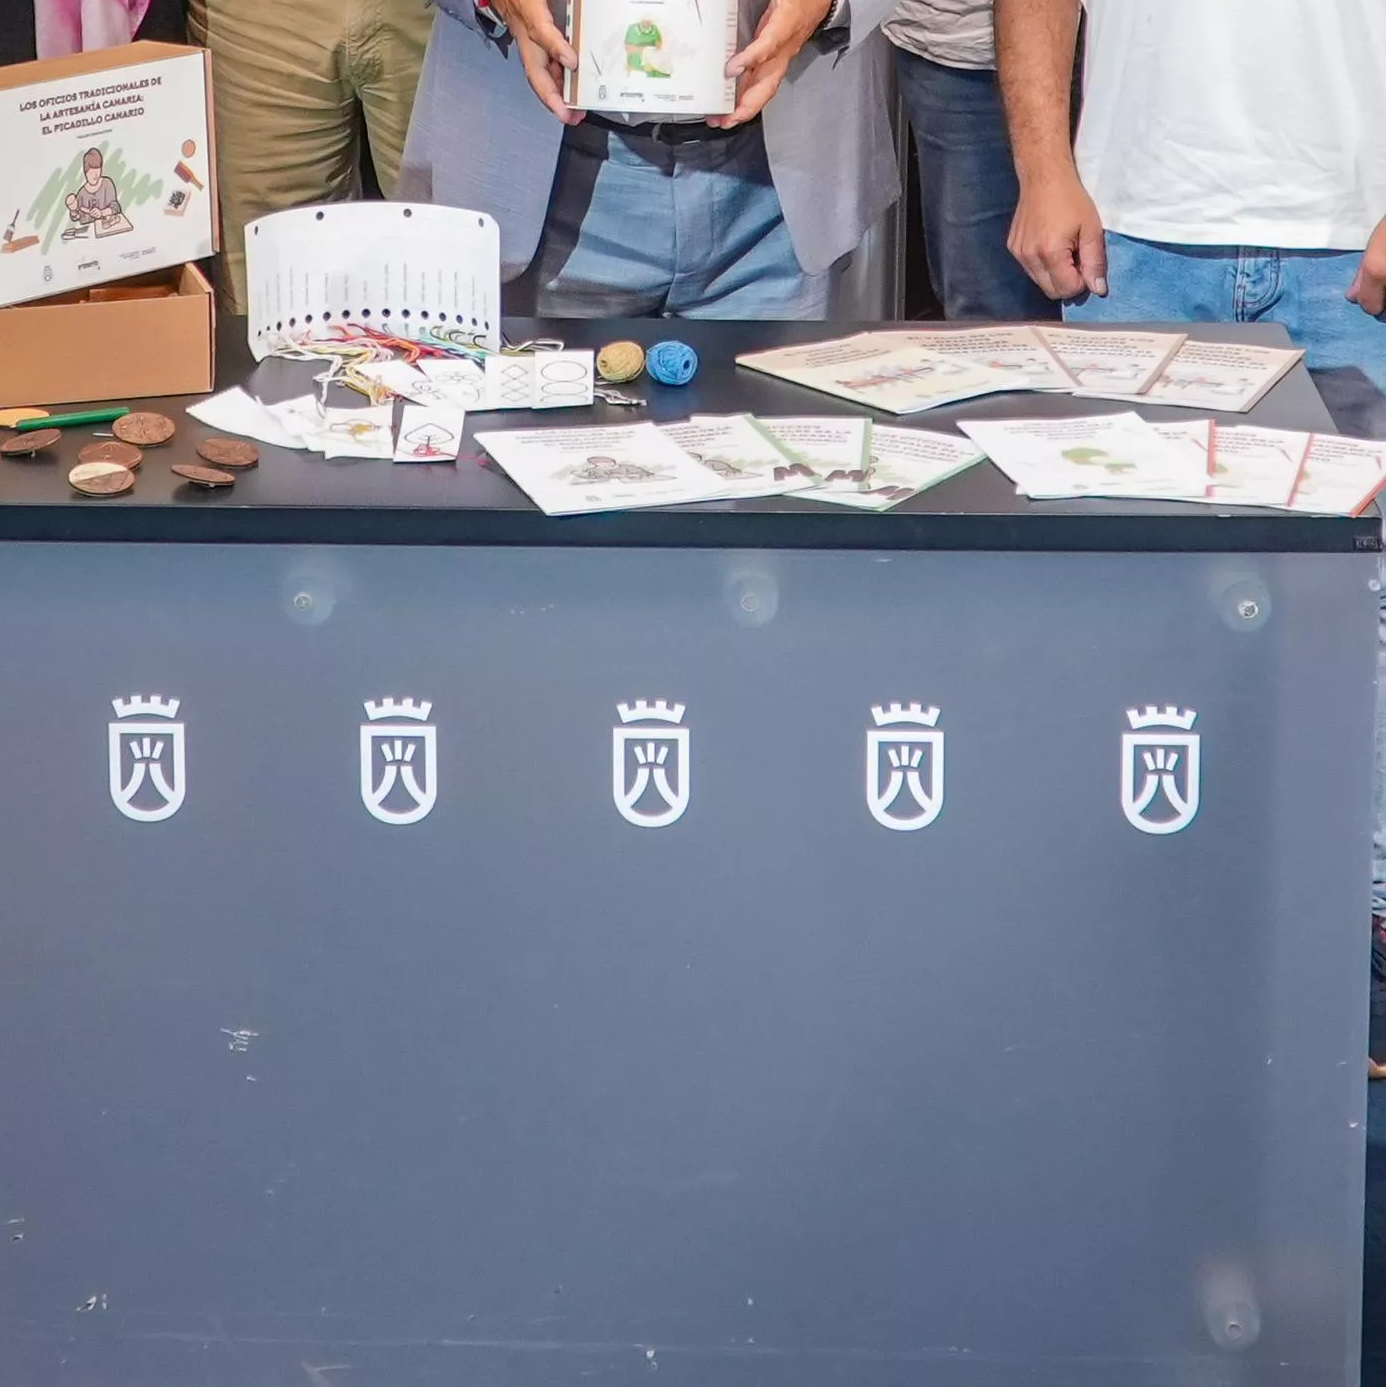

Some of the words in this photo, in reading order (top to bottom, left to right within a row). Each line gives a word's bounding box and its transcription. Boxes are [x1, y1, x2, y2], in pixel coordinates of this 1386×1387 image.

[19, 101, 37, 112] LOS
[38, 93, 78, 108] OFICIOS
[79, 78, 149, 100] TRADICIONALES
[151, 77, 162, 87] DE
[40, 112, 52, 122] LA
[42, 126, 53, 135] EL
[54, 116, 103, 133] PICADILLO
